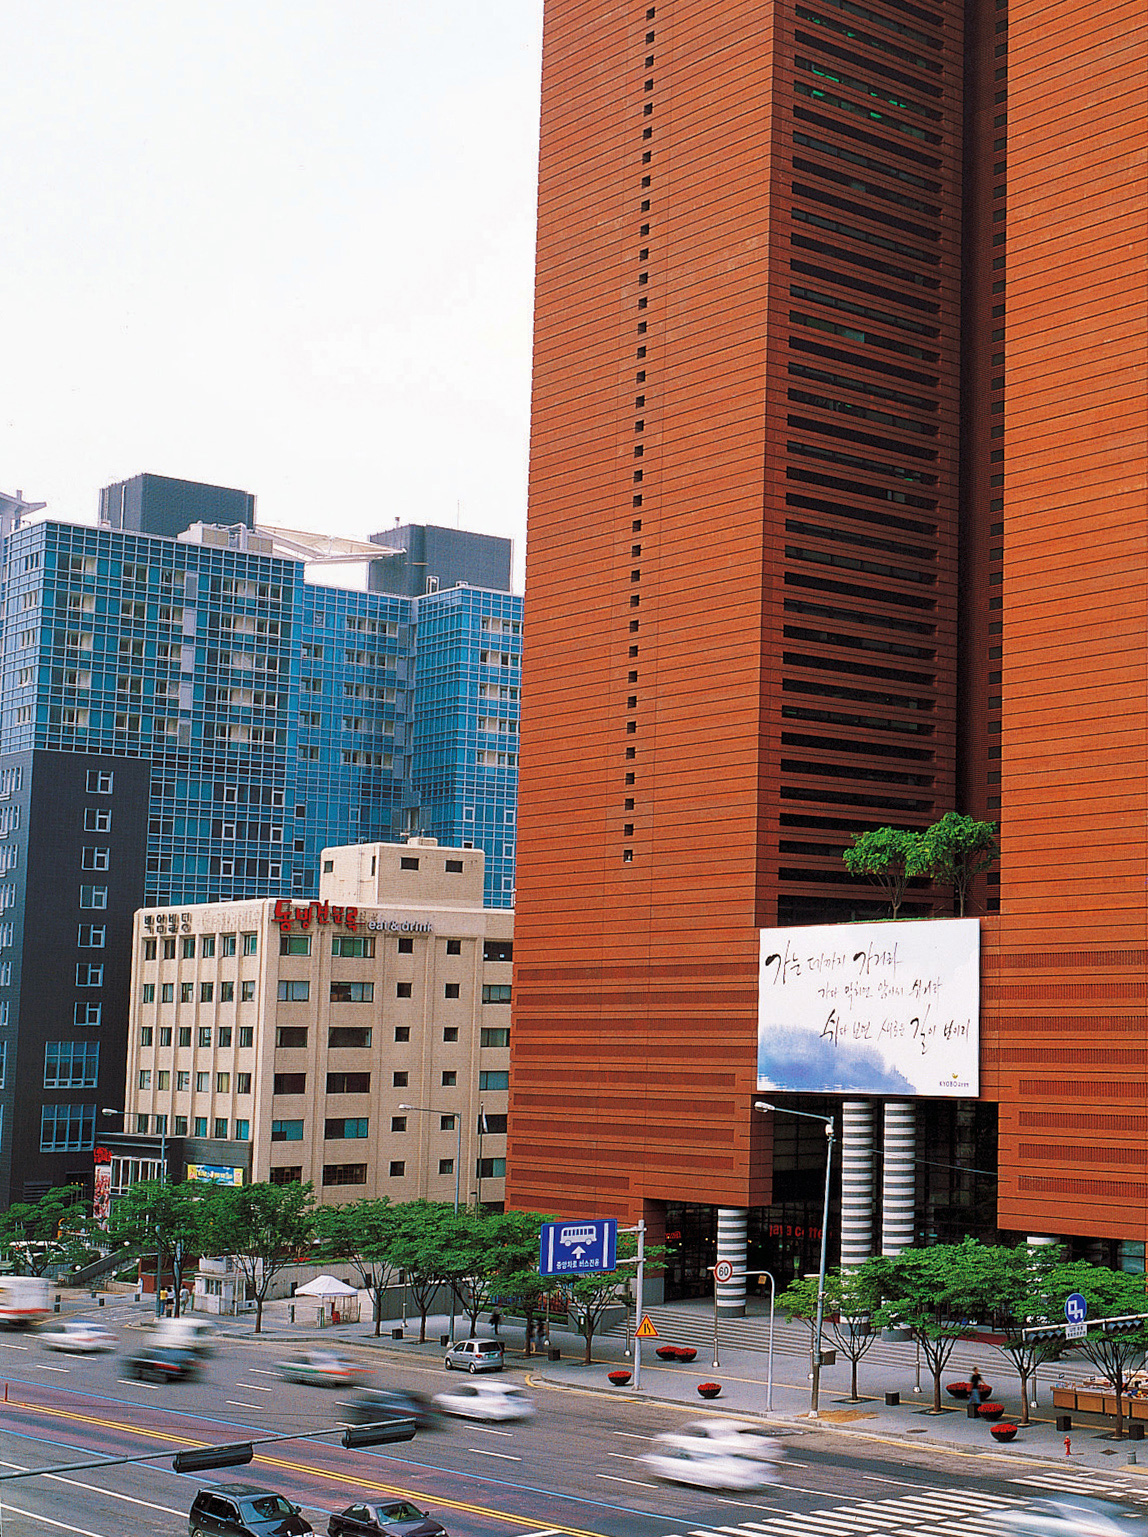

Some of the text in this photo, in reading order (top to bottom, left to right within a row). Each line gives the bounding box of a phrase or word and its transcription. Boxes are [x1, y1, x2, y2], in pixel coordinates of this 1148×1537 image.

[271, 899, 366, 932] 동방견문록
[765, 940, 903, 985] 가는 데까지 가거라
[818, 982, 838, 999] 가다
[844, 979, 873, 1010] 막히면
[820, 1004, 971, 1055] 쉬다 보면 새로운 길이 보이리
[556, 1258, 600, 1270] 중앙차로 버스전용
[718, 1266, 729, 1277] 60
